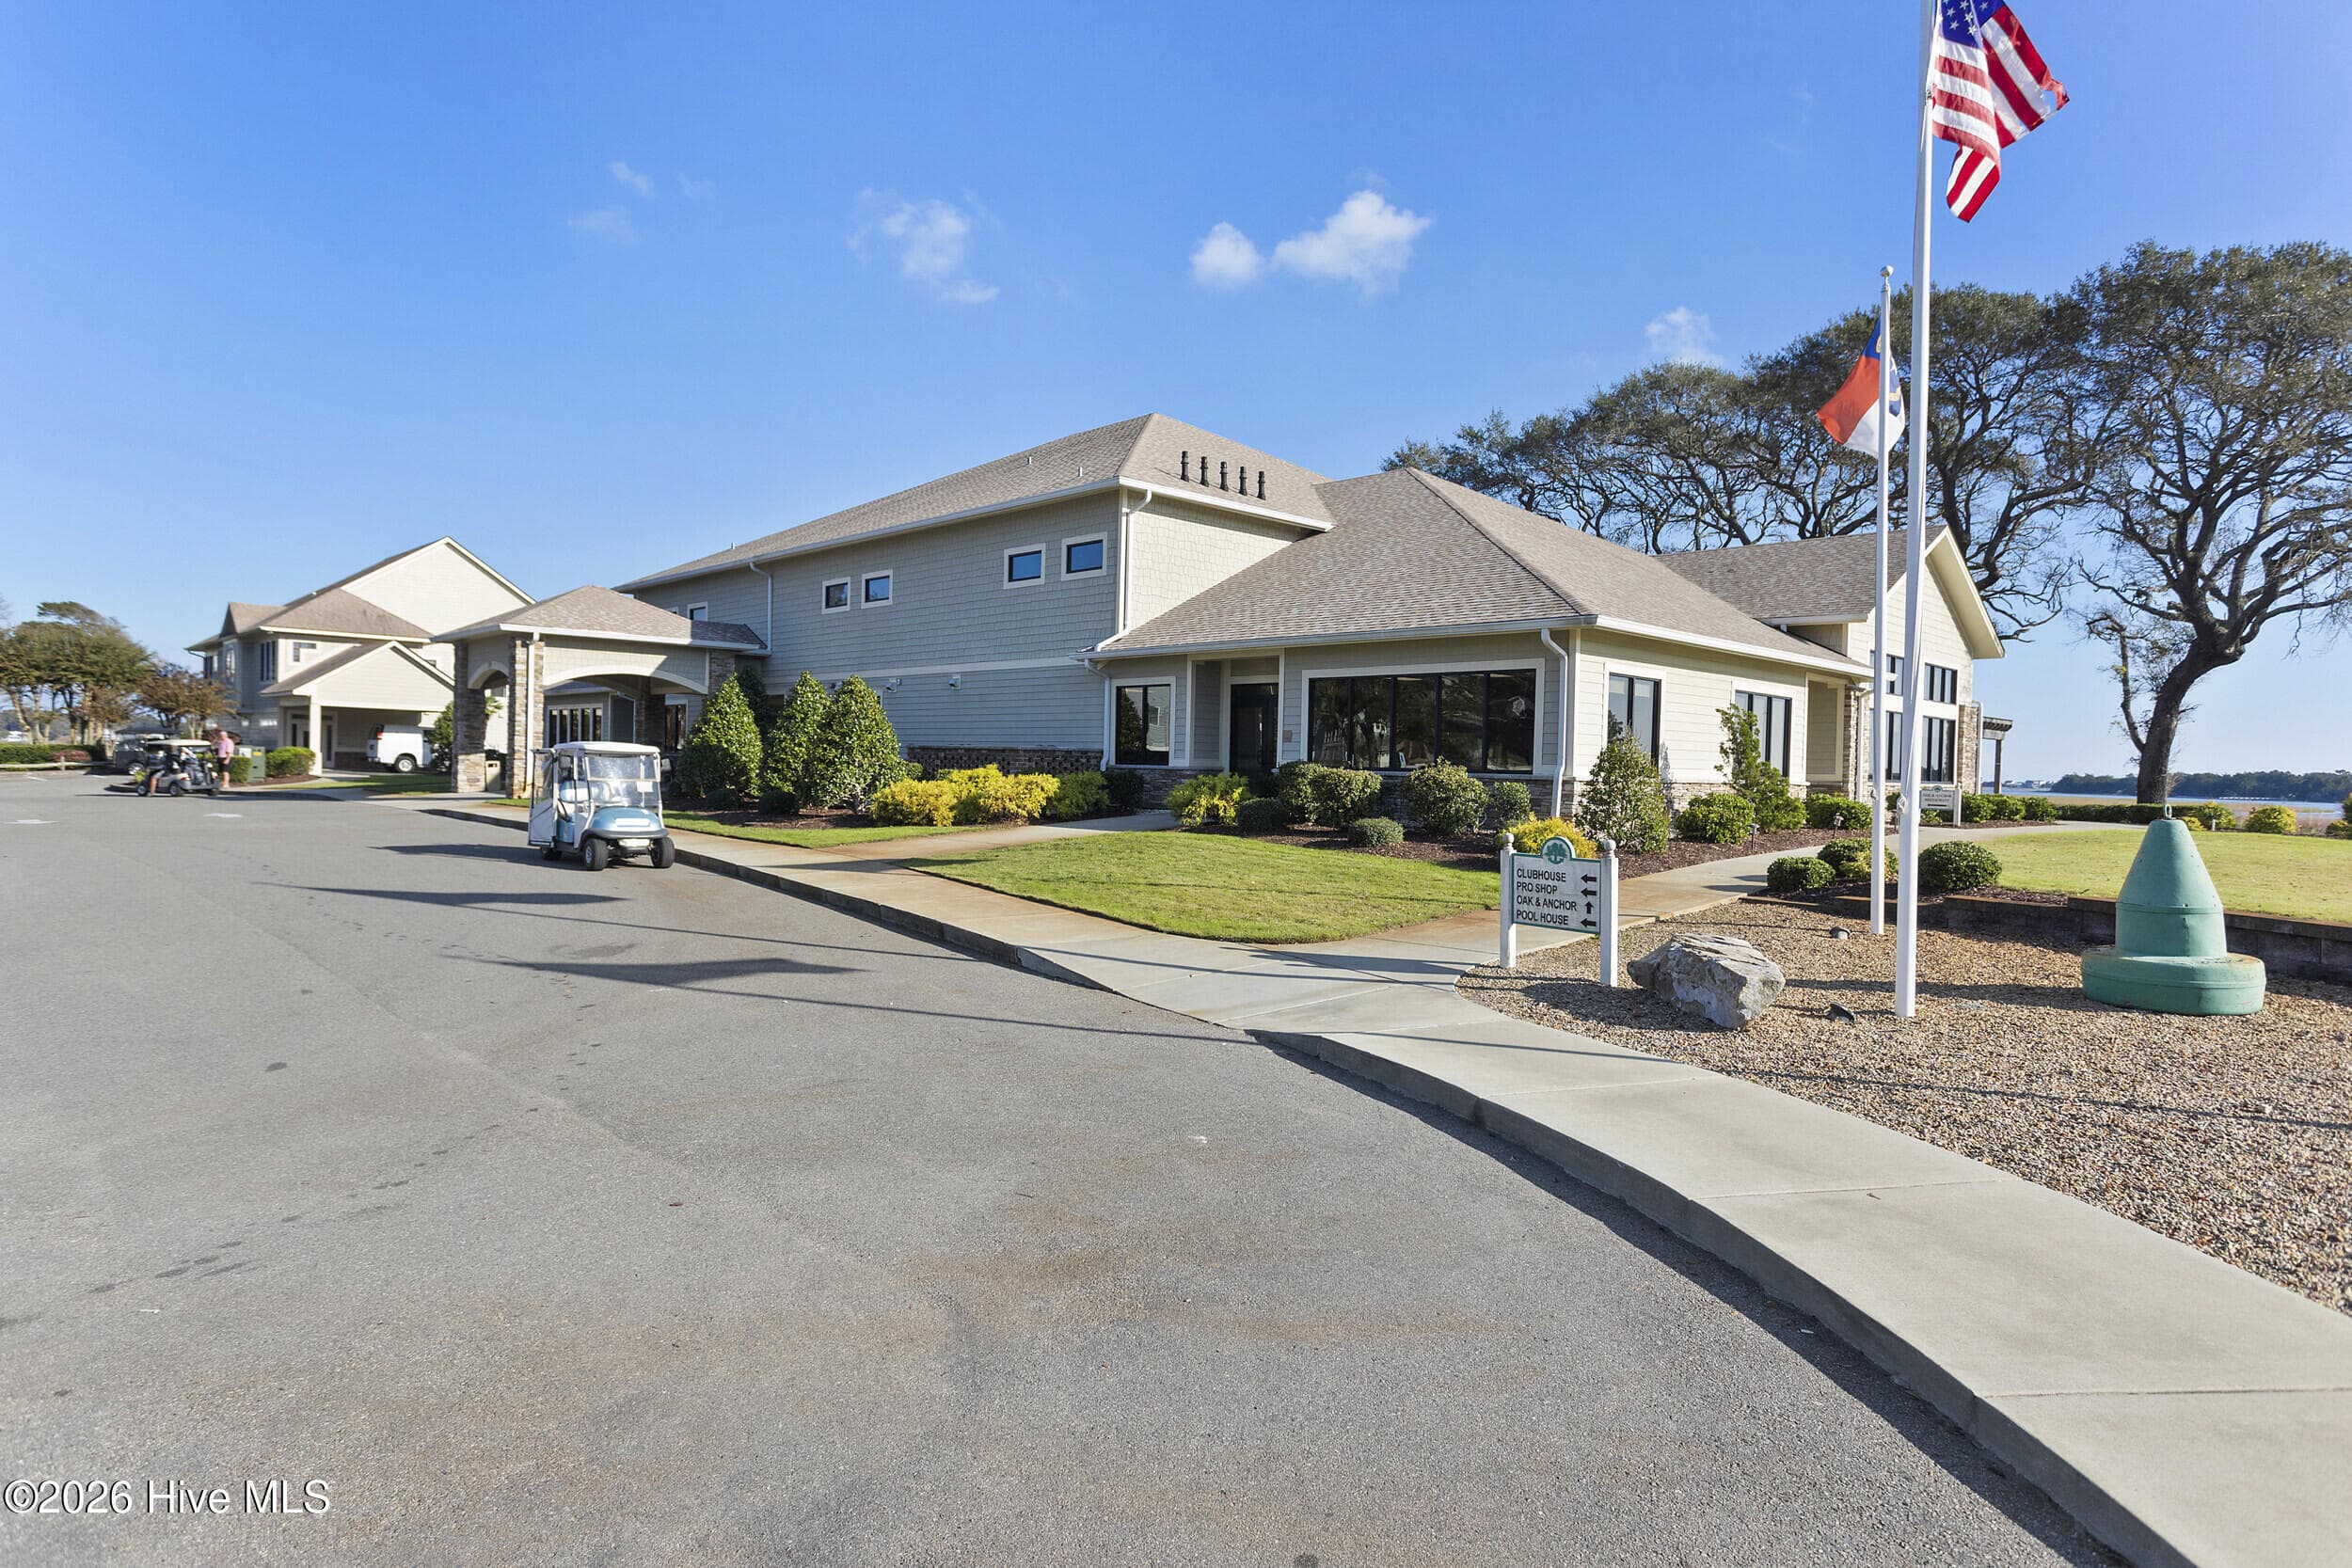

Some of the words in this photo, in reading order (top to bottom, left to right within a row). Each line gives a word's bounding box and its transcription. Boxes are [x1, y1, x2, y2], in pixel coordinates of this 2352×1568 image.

[1517, 868, 1566, 882] CLUBHOUSE
[1517, 881, 1534, 893] PRO
[1535, 882, 1558, 895] SHOP
[1517, 895, 1534, 907] OAK
[1535, 897, 1541, 907] &
[1543, 899, 1578, 911] ANCHOR
[1517, 910, 1538, 922] POOL
[1540, 912, 1568, 926] HOUSE
